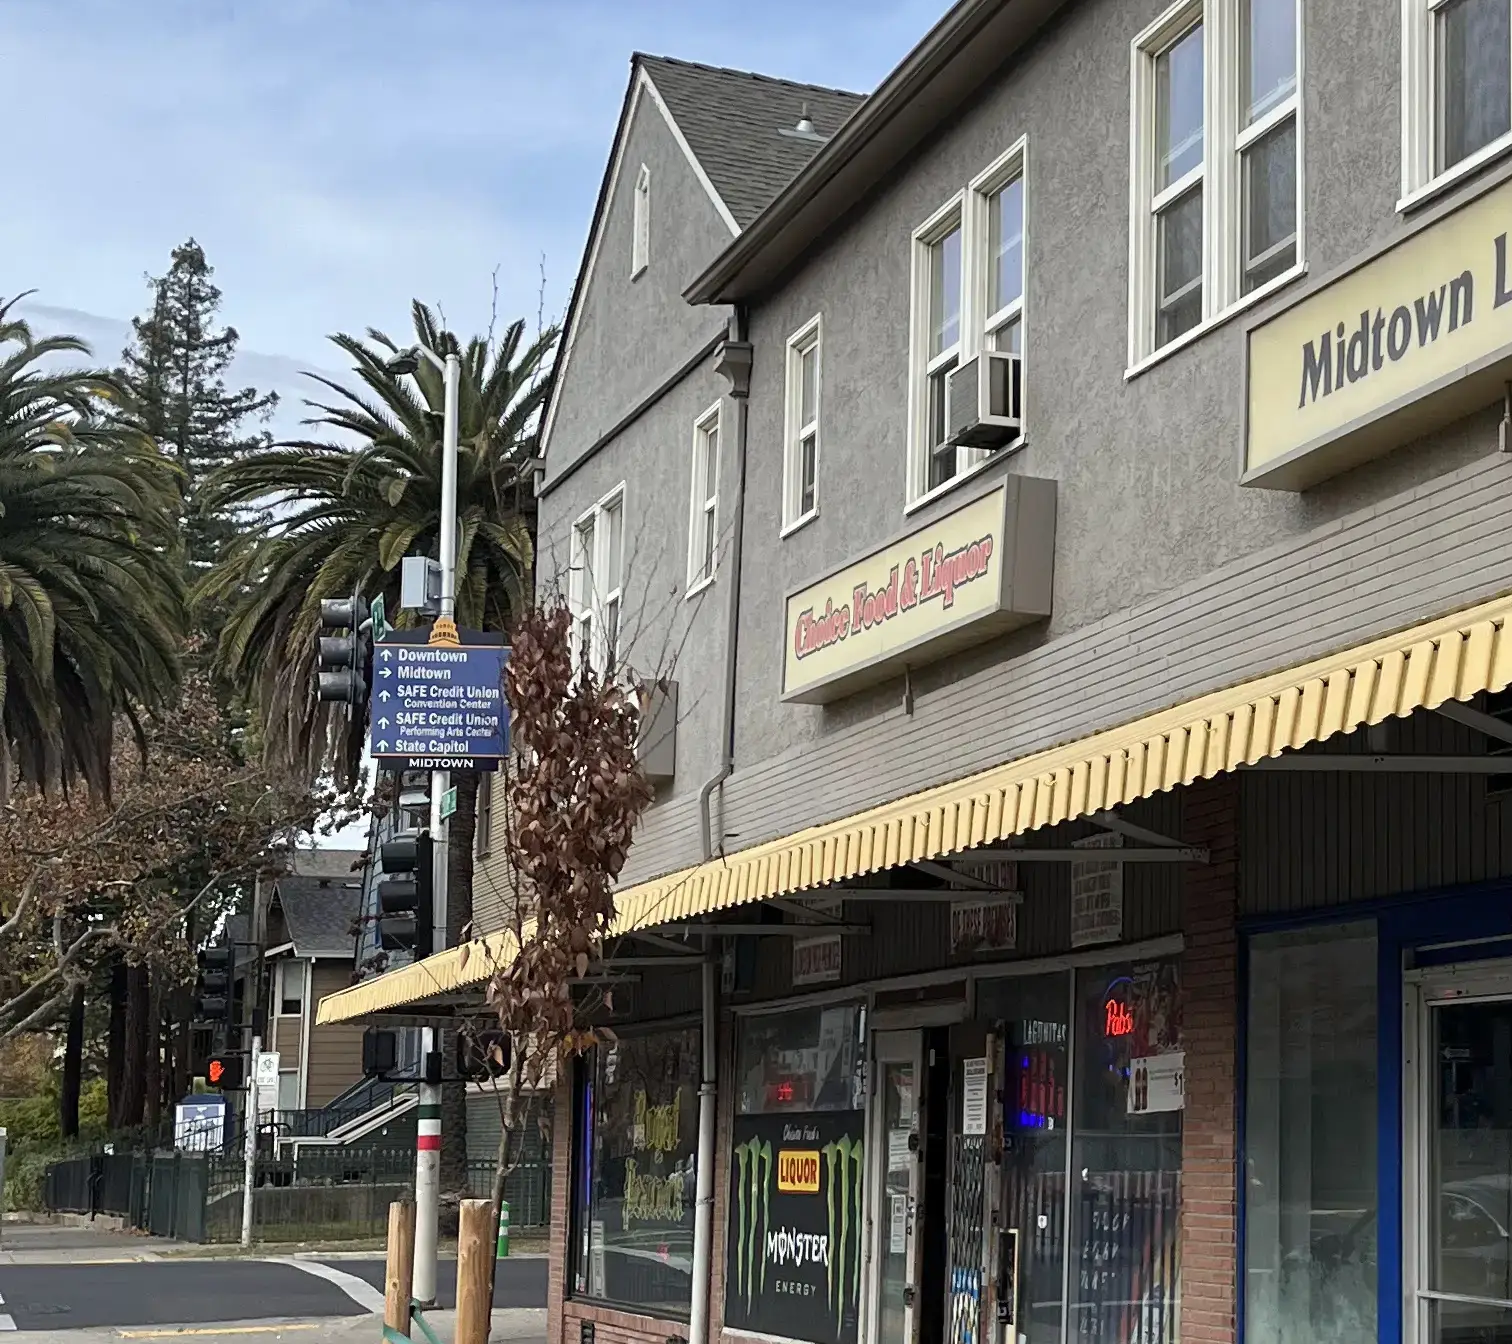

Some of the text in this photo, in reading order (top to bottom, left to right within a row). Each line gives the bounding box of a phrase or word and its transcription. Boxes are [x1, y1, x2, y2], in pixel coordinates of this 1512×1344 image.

[1298, 270, 1474, 410] Midtown
[795, 534, 993, 660] Choice Food & Liquor
[398, 649, 468, 662] Downtown
[397, 666, 451, 679] Midtown
[397, 685, 500, 698] SAFE Credit Union
[404, 698, 491, 709] Convention Center
[396, 712, 498, 726] SAFE Credit Union
[400, 726, 493, 739] Performing Arts Center
[395, 739, 469, 754] State Capitol
[409, 758, 474, 768] MIDTOWN
[780, 1157, 817, 1185] LIQUOR
[767, 1226, 828, 1267] MONSTER
[775, 1280, 817, 1296] ENERGY
